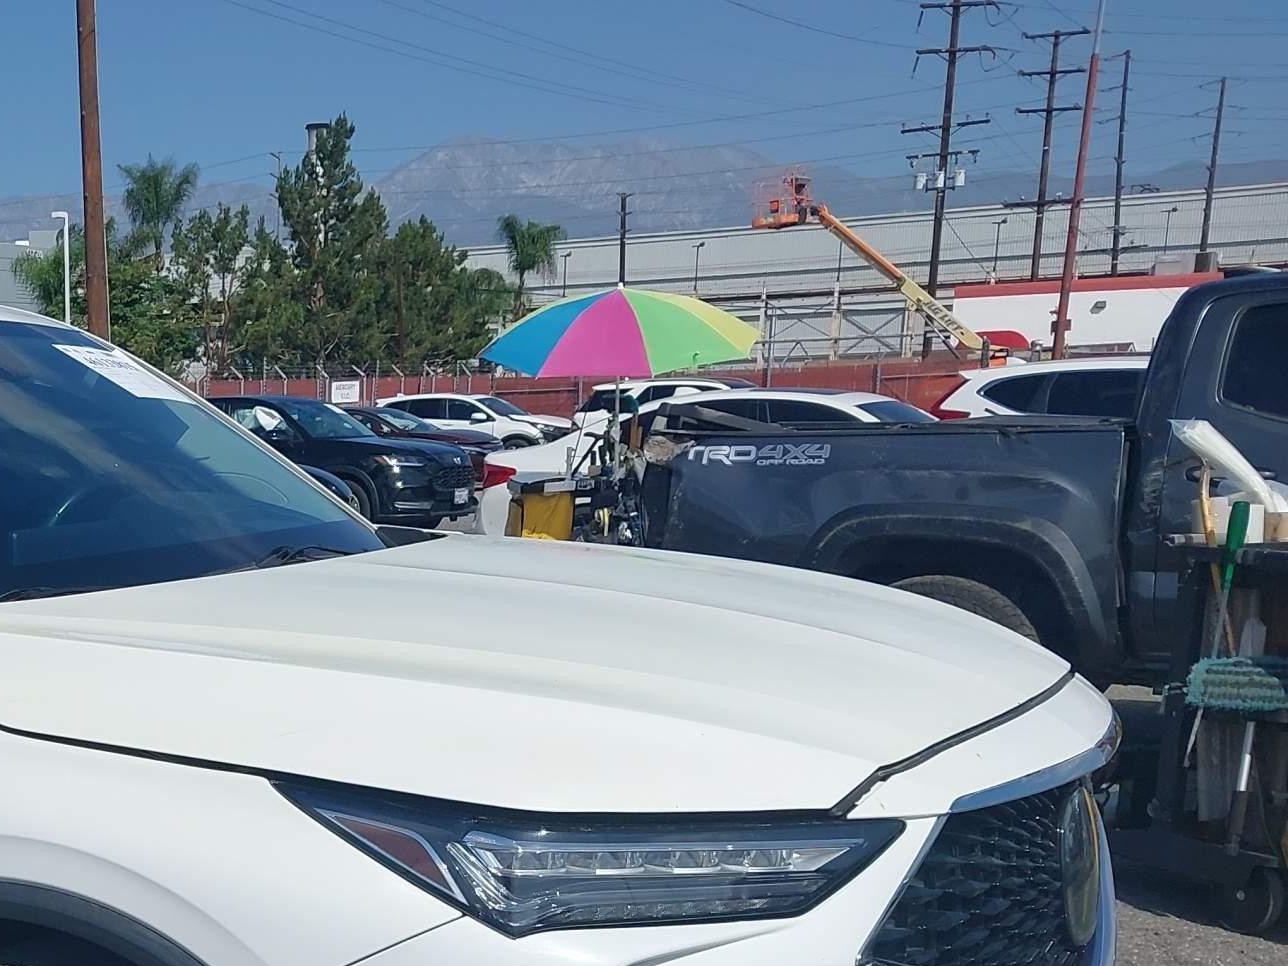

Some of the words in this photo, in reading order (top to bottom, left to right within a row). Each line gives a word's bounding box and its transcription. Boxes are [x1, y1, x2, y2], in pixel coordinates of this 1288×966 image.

[939, 314, 965, 331] LIFT
[687, 445, 758, 465] TRD
[785, 458, 826, 466] ROAD
